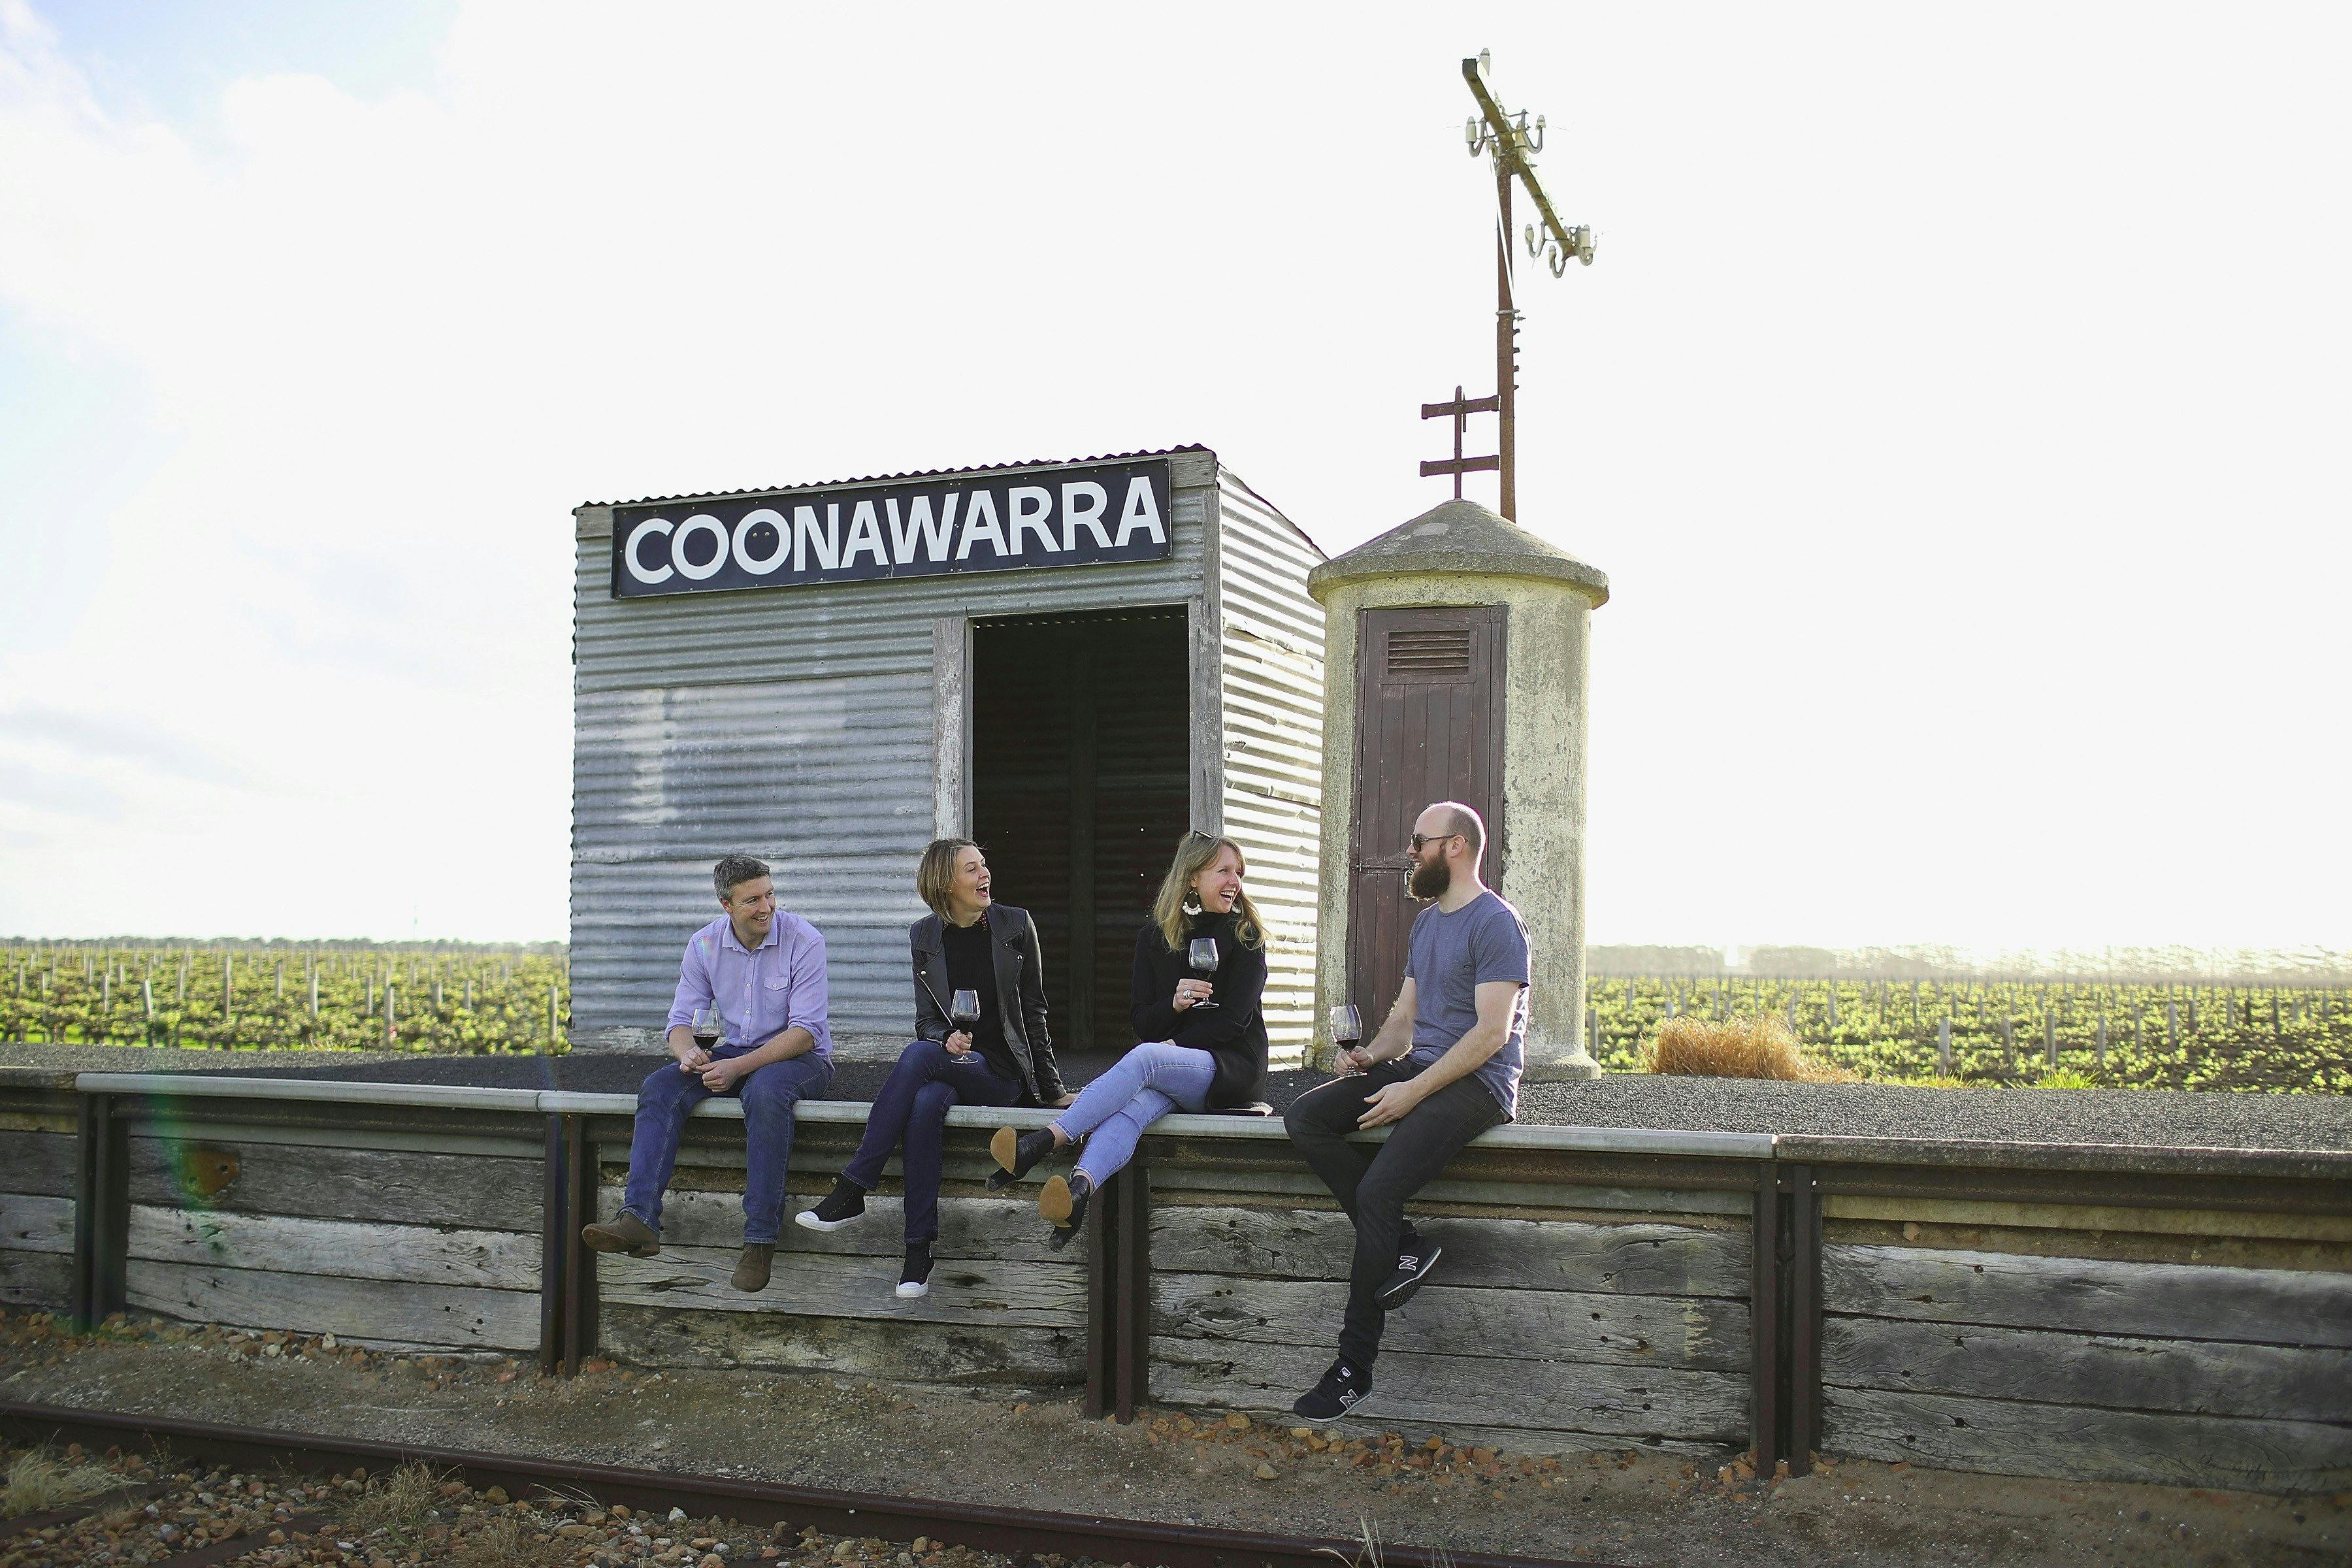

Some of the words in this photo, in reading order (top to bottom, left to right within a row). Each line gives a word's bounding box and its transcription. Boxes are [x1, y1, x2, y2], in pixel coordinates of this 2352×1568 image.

[625, 476, 1166, 584] COONAWARRA
[1399, 1255, 1418, 1271] N
[1339, 1389, 1358, 1409] N
